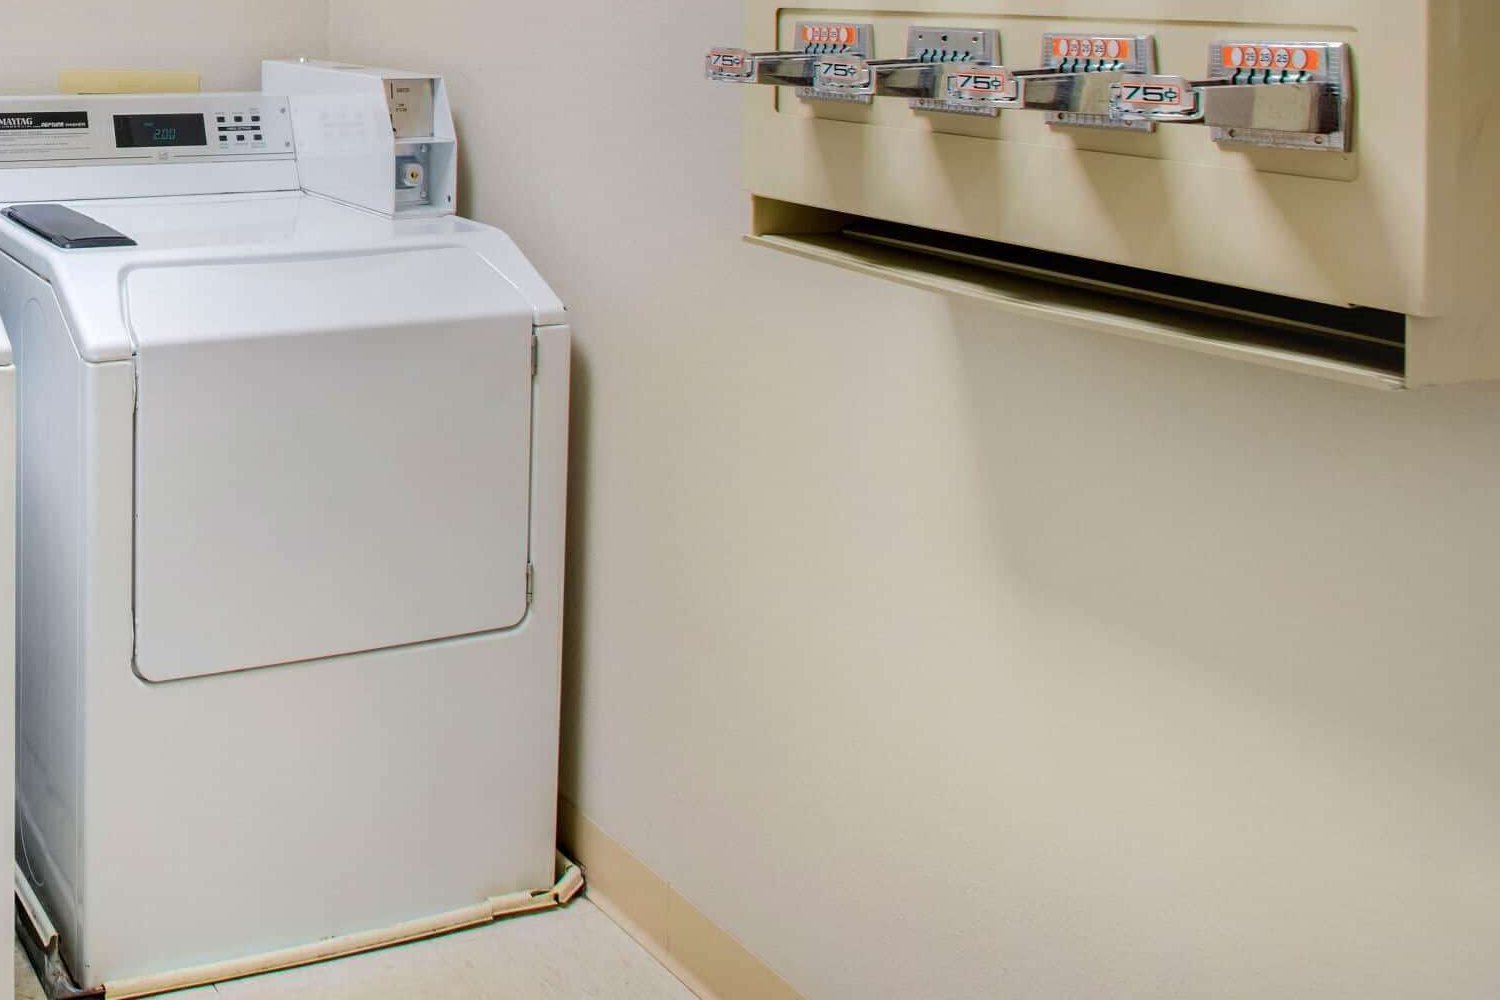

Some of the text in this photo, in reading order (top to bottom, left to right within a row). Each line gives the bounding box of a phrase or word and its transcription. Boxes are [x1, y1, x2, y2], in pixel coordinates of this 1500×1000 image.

[712, 54, 741, 67] 75¢
[1246, 52, 1255, 61] 25
[1260, 53, 1269, 62] 25
[1276, 54, 1287, 63] 25
[822, 63, 855, 77] 75¢
[958, 74, 1002, 90] 75¢
[1124, 85, 1178, 103] 75¢
